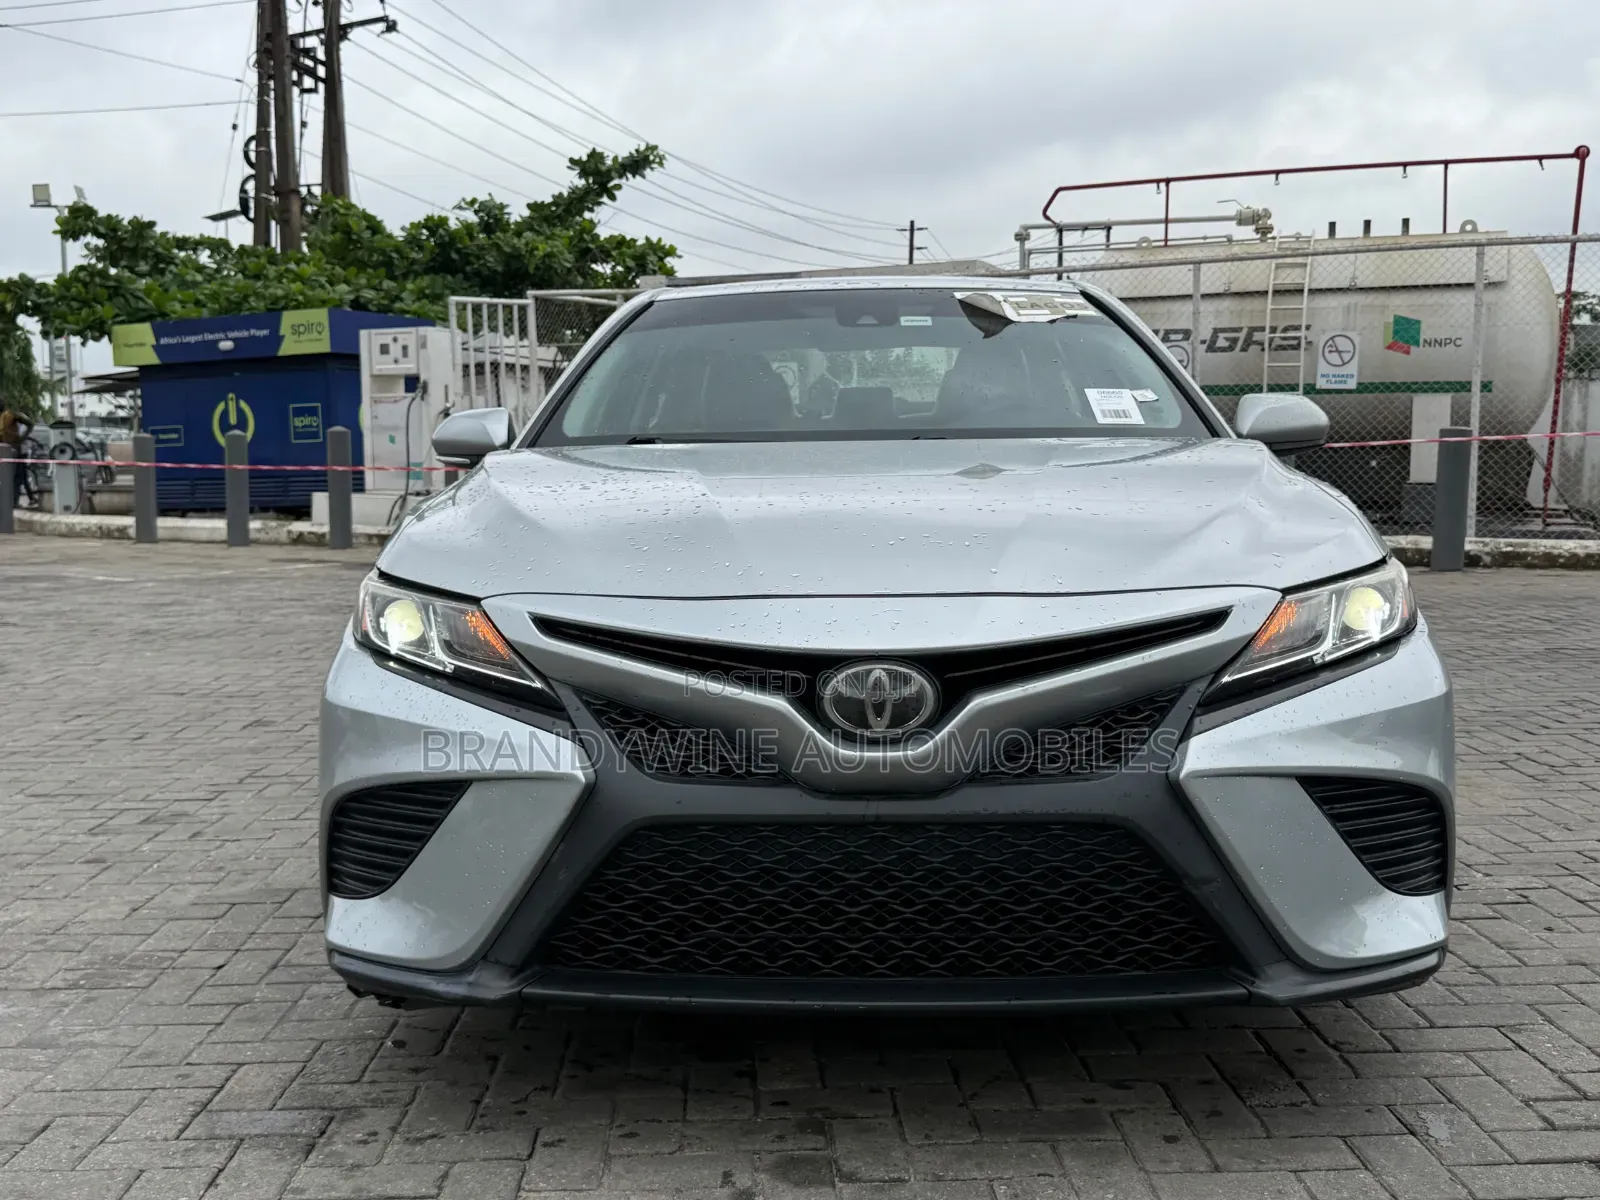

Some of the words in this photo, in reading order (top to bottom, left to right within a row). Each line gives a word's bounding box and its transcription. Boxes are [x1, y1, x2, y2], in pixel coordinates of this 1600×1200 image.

[160, 336, 181, 345] Africa's
[182, 333, 204, 344] Largest
[204, 331, 226, 341] Electric
[227, 329, 249, 339] Vehicle
[249, 328, 270, 338] Player
[1422, 337, 1463, 348] NNPC
